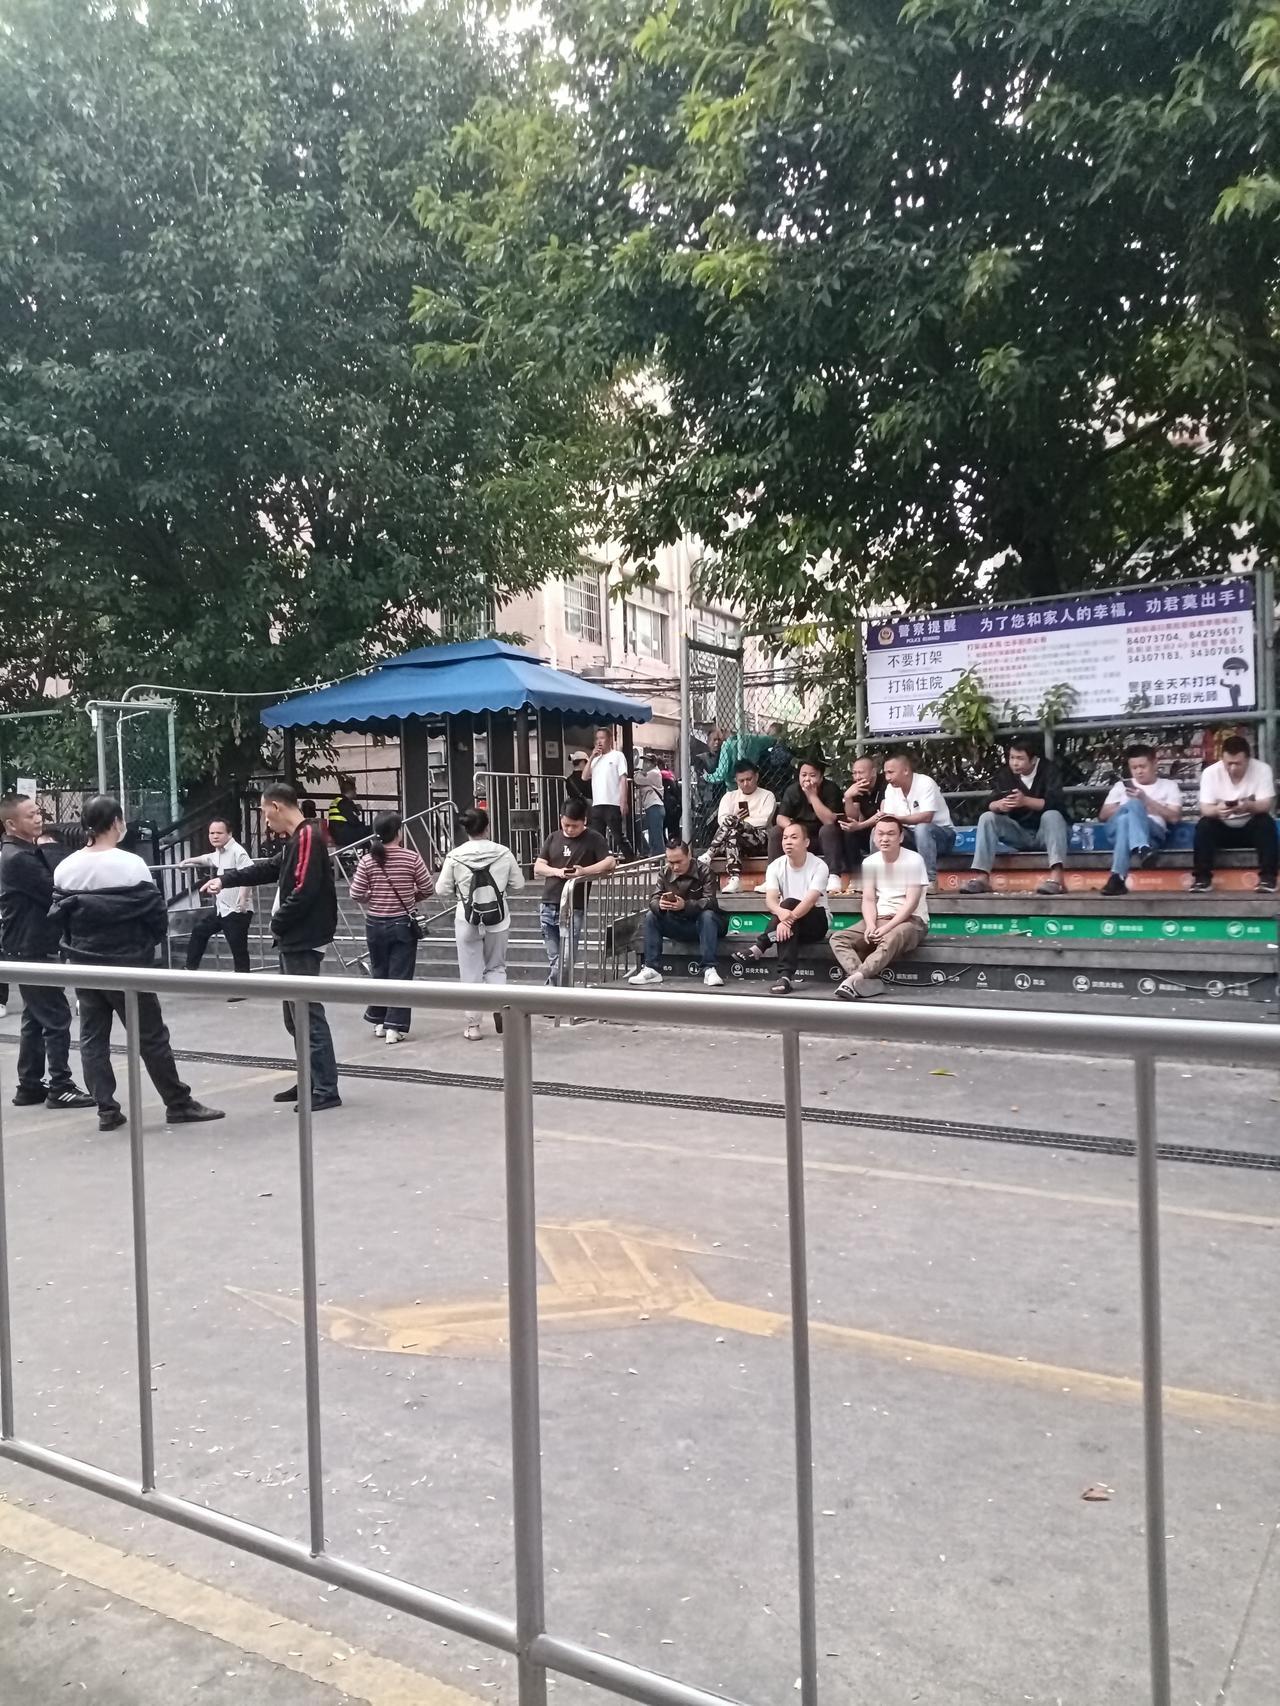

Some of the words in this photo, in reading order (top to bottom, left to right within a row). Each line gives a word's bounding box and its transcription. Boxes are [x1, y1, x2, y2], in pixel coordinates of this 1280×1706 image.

[898, 619, 957, 638] 警察提醒
[888, 650, 943, 668] 不要打架
[888, 676, 944, 693] 打输住院
[563, 845, 571, 856] LA
